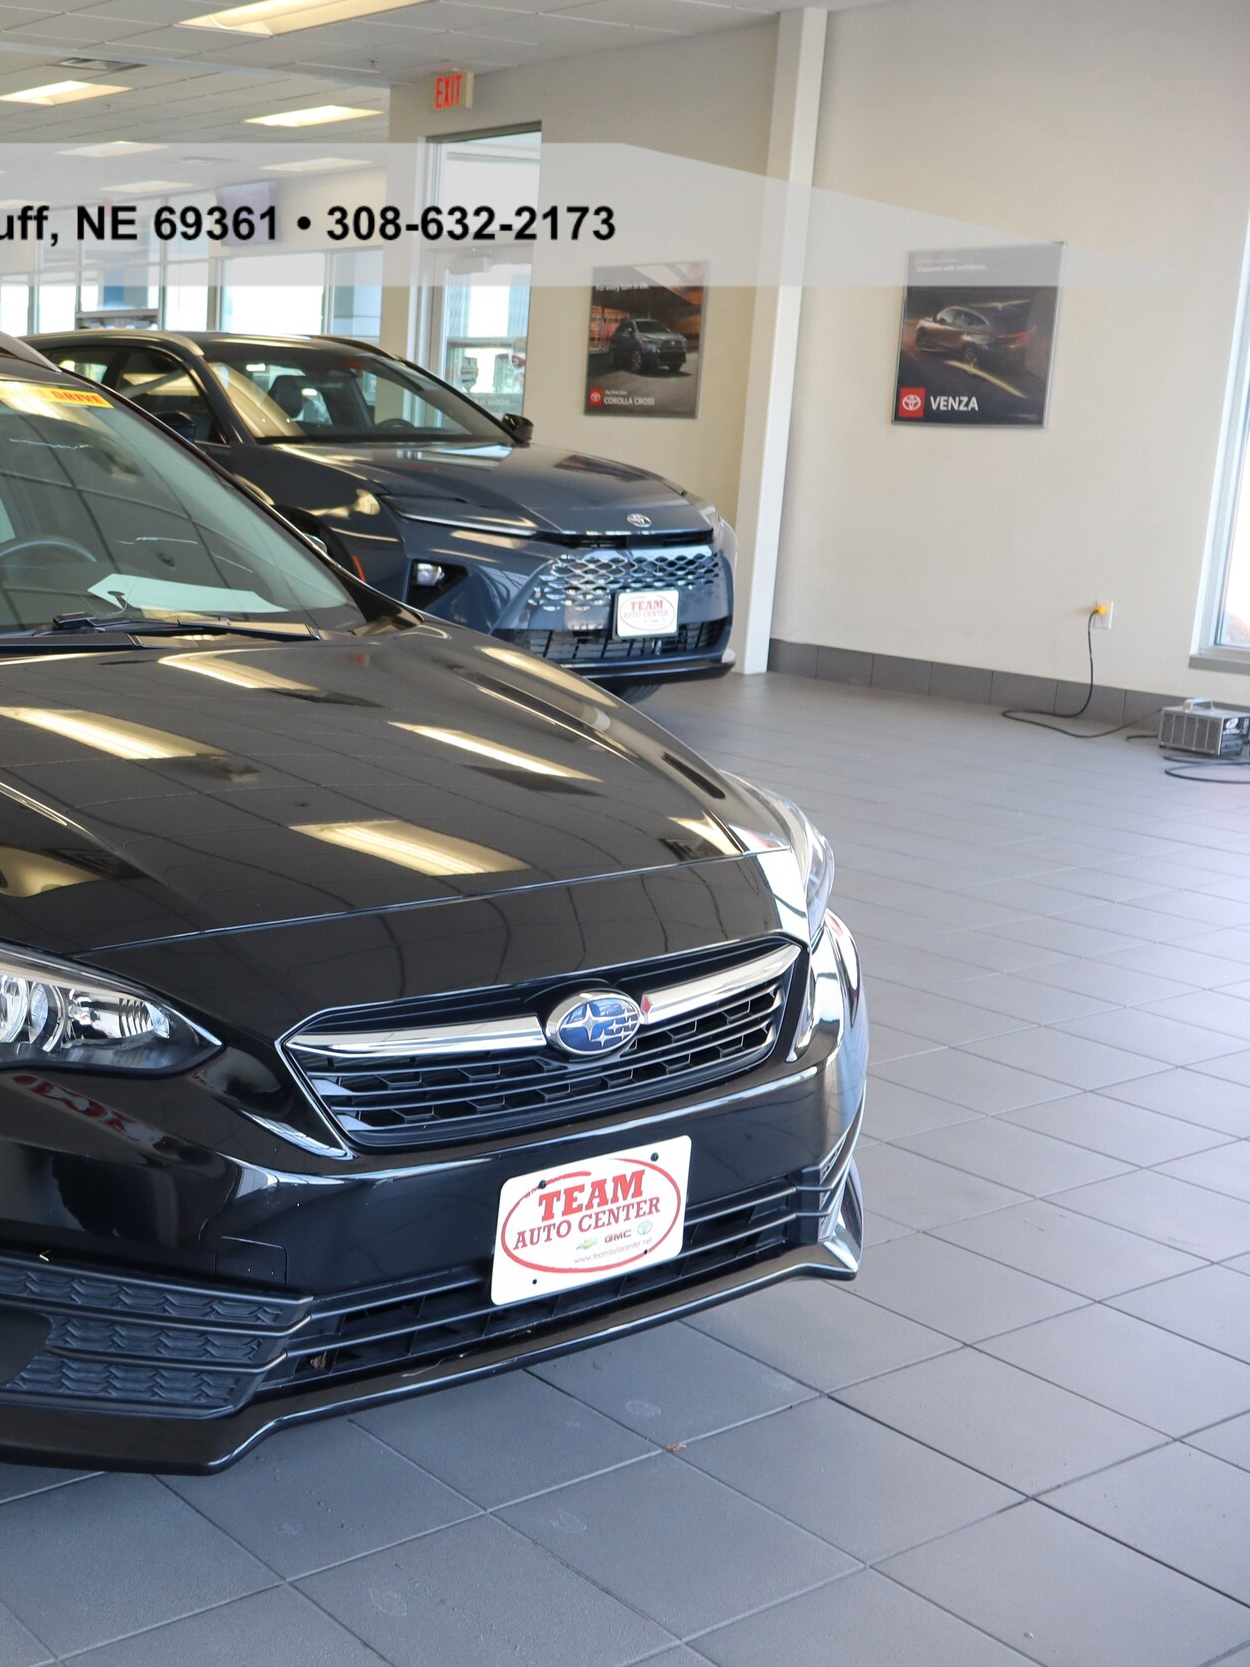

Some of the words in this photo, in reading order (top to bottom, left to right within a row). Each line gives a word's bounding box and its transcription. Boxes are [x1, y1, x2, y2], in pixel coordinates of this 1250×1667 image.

[435, 74, 462, 109] EXIT
[51, 390, 106, 404] DRIVE
[603, 397, 633, 405] COROLLA
[634, 397, 655, 405] CROSS
[930, 395, 979, 411] VENZA
[630, 600, 664, 611] TEAM
[538, 1169, 645, 1222] TEAM
[513, 1219, 572, 1250] AUTO
[577, 1196, 661, 1233] CENTER
[604, 1229, 632, 1243] GMC
